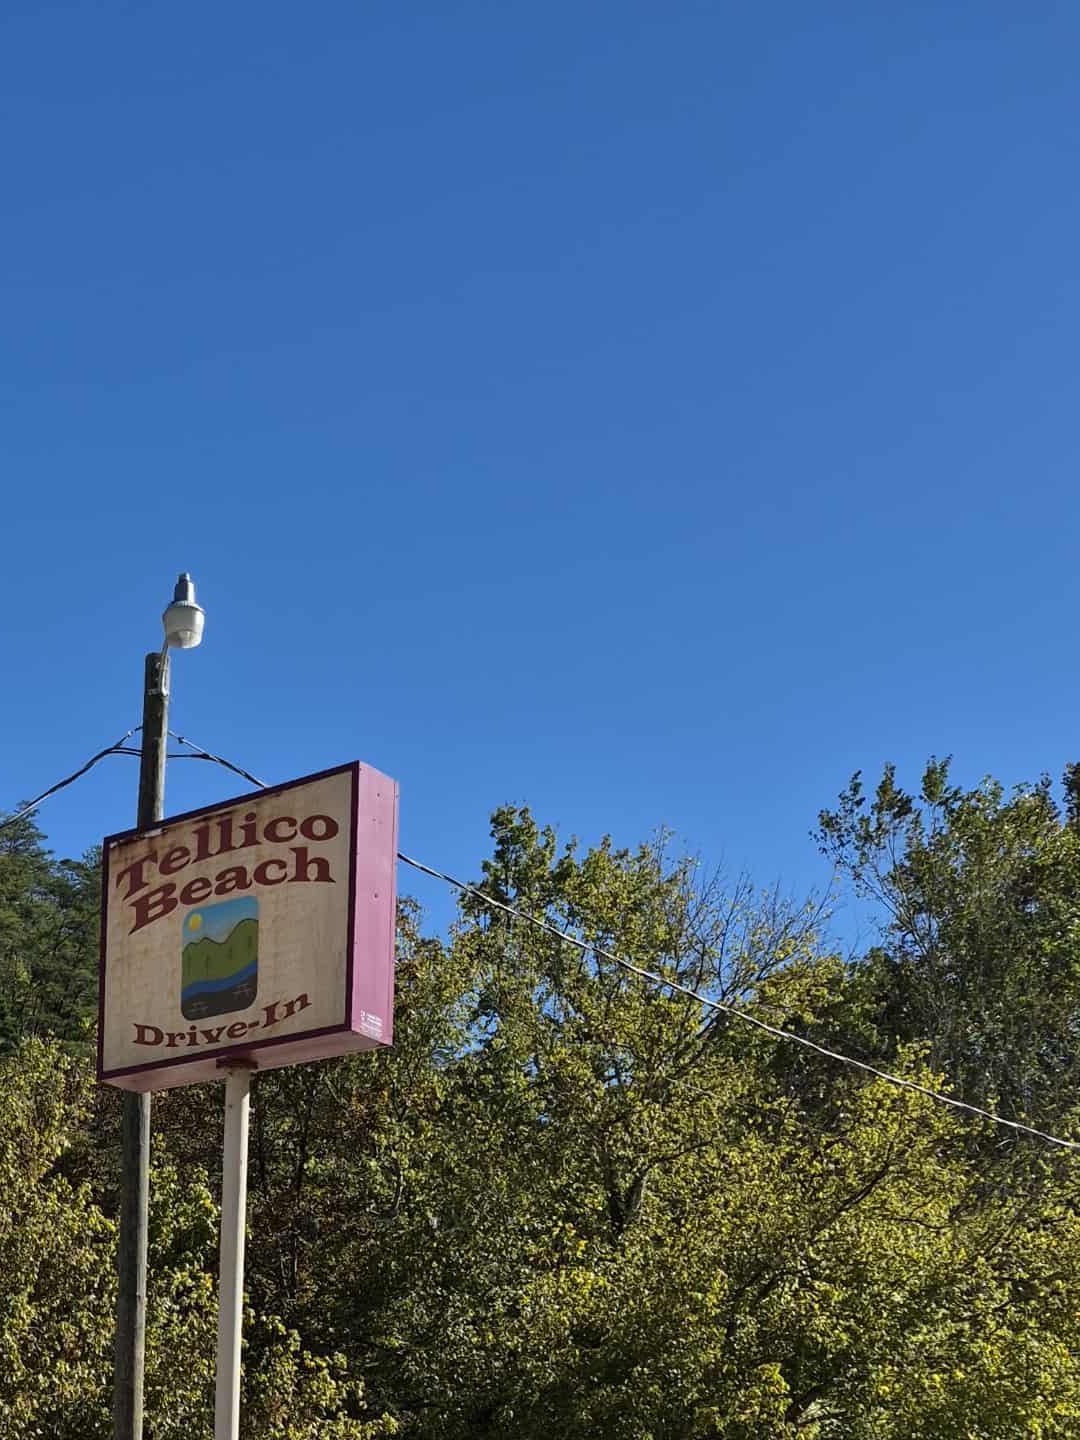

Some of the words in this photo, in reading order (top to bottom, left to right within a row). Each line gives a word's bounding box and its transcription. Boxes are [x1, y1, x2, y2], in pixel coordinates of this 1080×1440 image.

[116, 812, 339, 901] Tellico
[127, 846, 337, 936] Beach
[132, 993, 312, 1048] Drive-In
